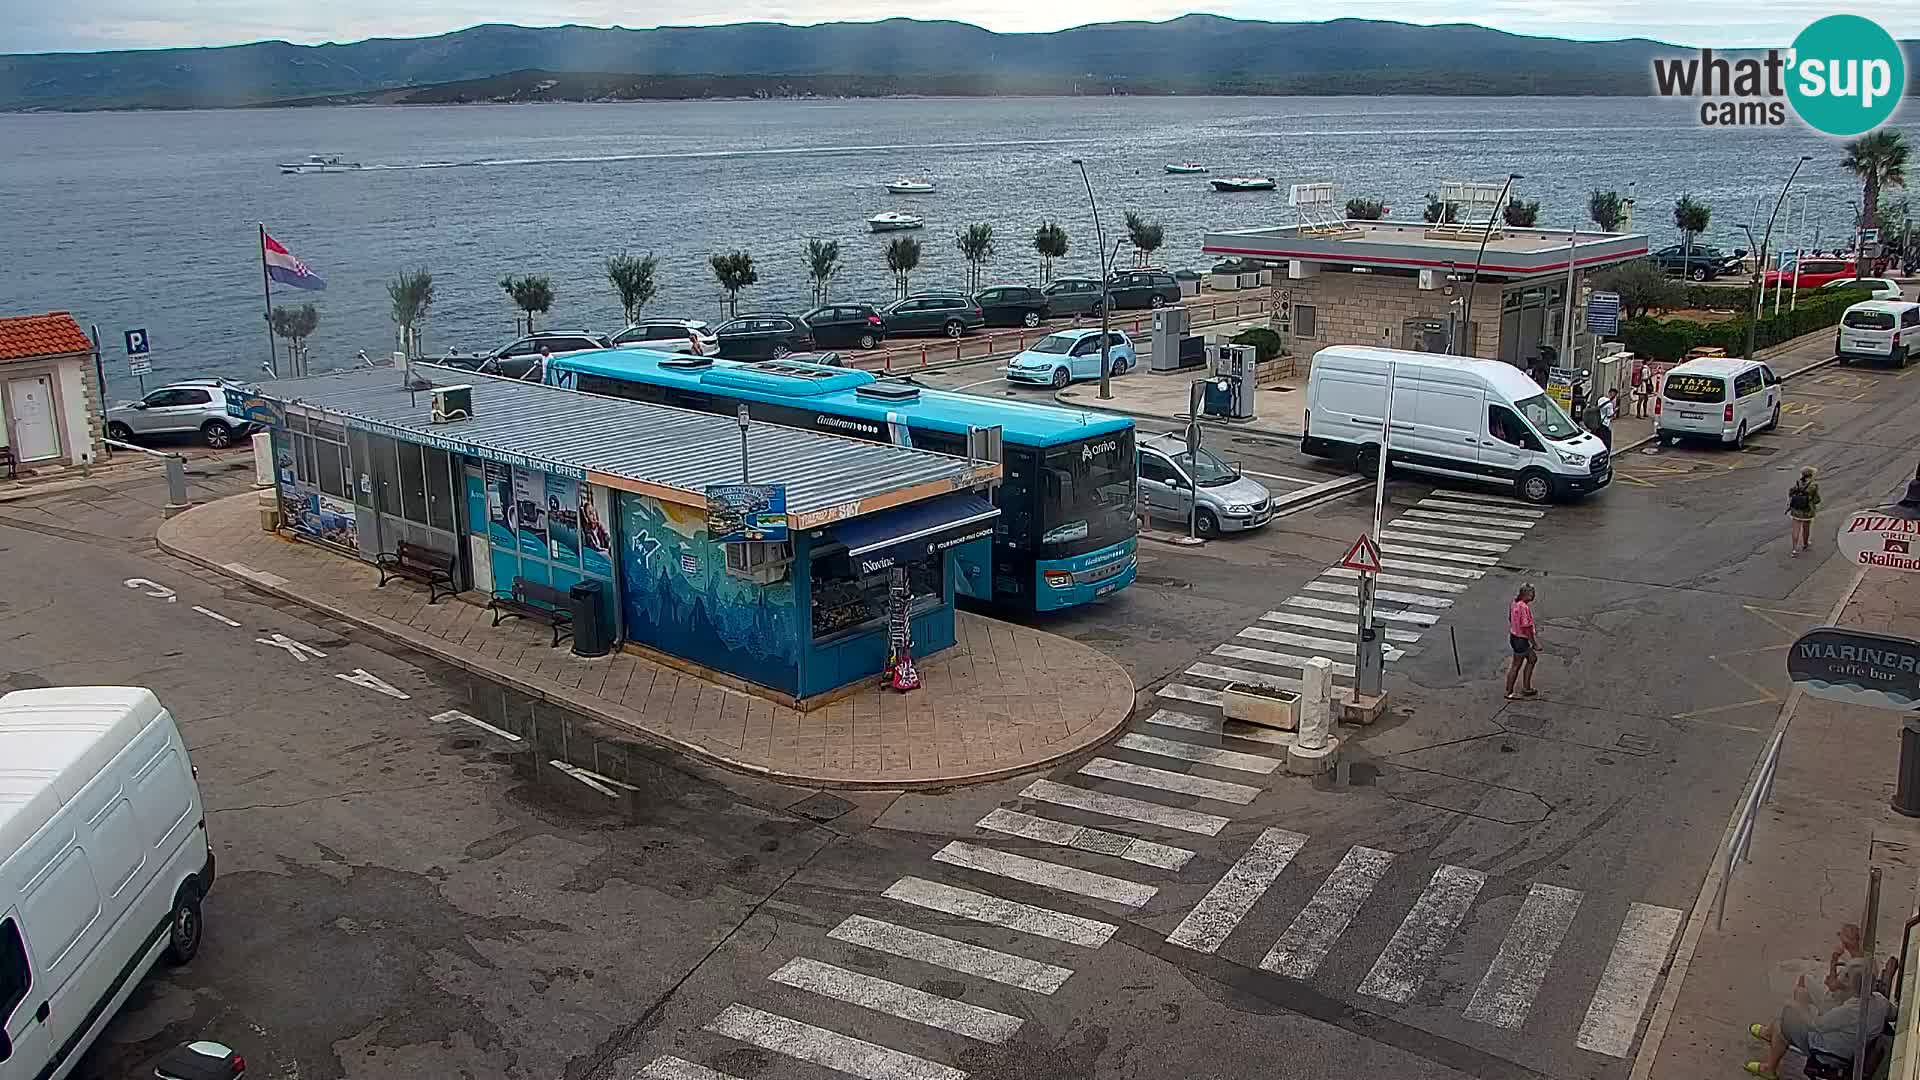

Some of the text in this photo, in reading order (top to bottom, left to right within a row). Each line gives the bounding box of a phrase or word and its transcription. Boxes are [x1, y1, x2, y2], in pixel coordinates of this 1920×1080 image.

[130, 332, 143, 352] P
[1680, 377, 1712, 386] TAXI
[1092, 440, 1116, 455] arriva
[436, 439, 468, 454] POSTAJA
[478, 448, 493, 459] BUS
[494, 450, 526, 467] STATION
[527, 458, 554, 473] TICKET
[555, 466, 582, 479] OFFICE
[1847, 516, 1920, 535] PIZZE
[1881, 531, 1916, 541] GRILL
[1828, 663, 1896, 681] caffe bar
